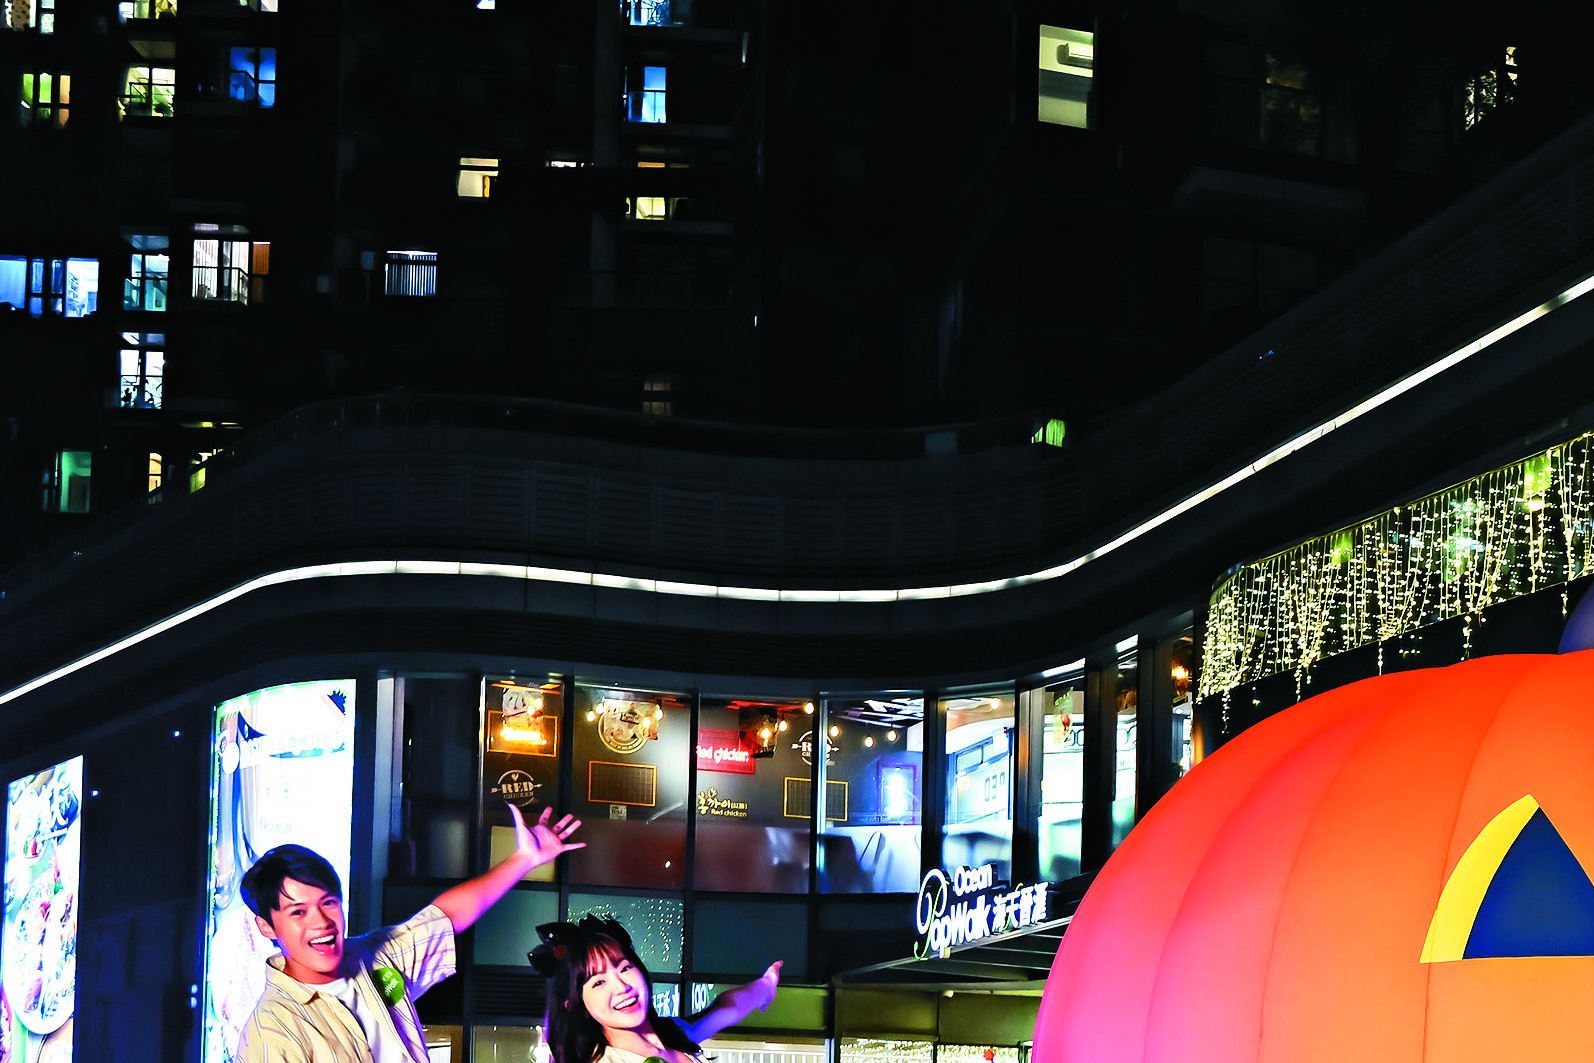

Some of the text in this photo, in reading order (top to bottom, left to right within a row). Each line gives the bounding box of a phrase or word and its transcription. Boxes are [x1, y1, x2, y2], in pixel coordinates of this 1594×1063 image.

[502, 781, 534, 793] RED
[953, 863, 993, 897] Ocean
[914, 868, 992, 960] PopWalk
